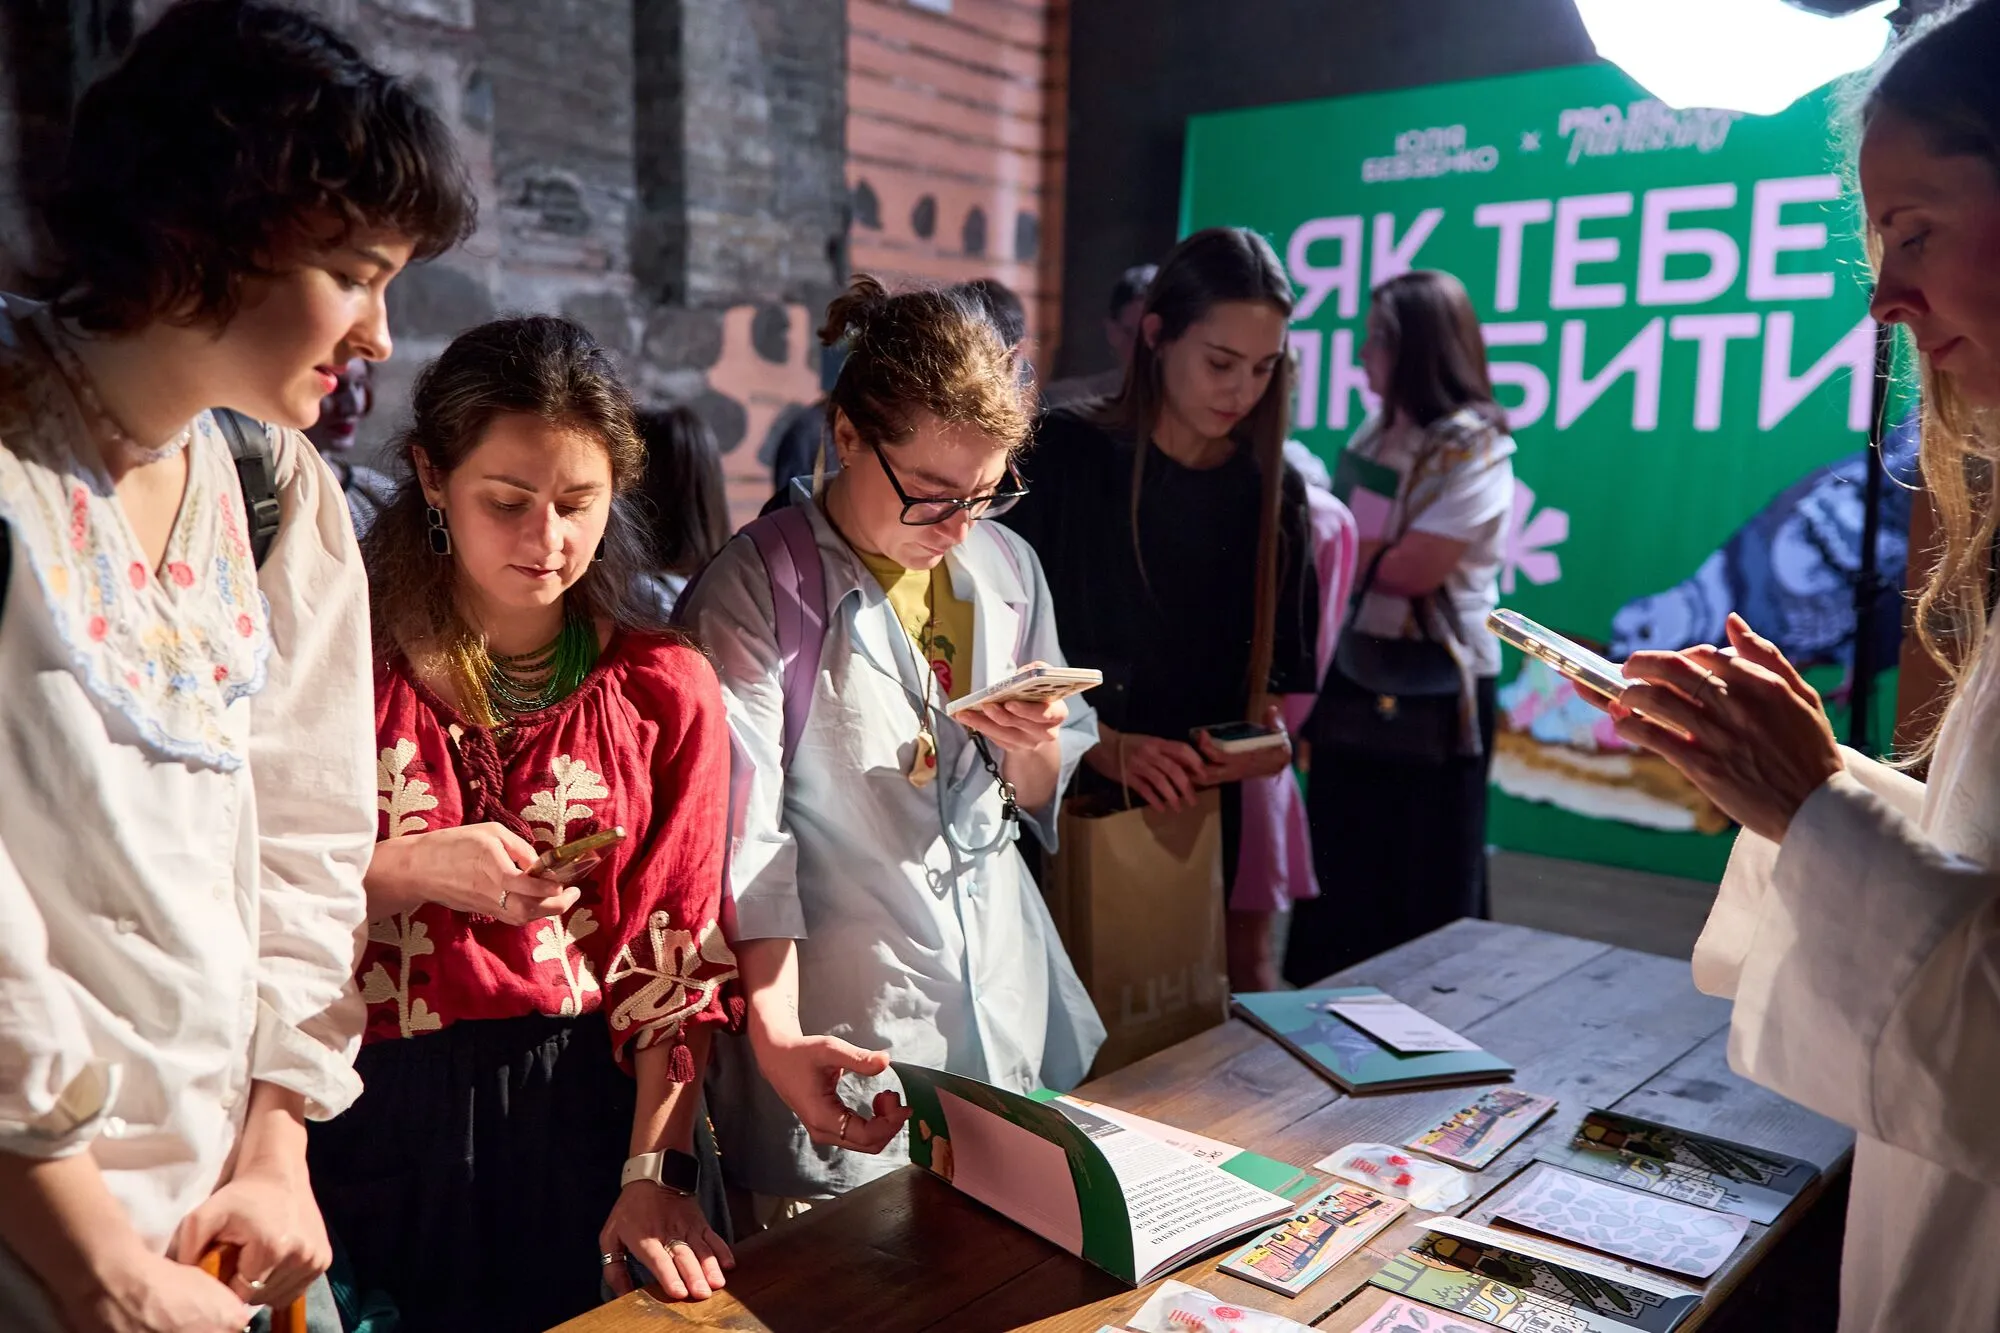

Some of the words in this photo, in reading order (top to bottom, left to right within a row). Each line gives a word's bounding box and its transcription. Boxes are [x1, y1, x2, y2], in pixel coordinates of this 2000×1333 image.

[1286, 209, 1445, 319] ЯК
[1474, 176, 1842, 313] ТЕБЕ
[1242, 1195, 1272, 1207] Поки
[1149, 1208, 1201, 1235] ренесанс
[1185, 1203, 1243, 1228] українська
[1150, 1225, 1186, 1245] сцена
